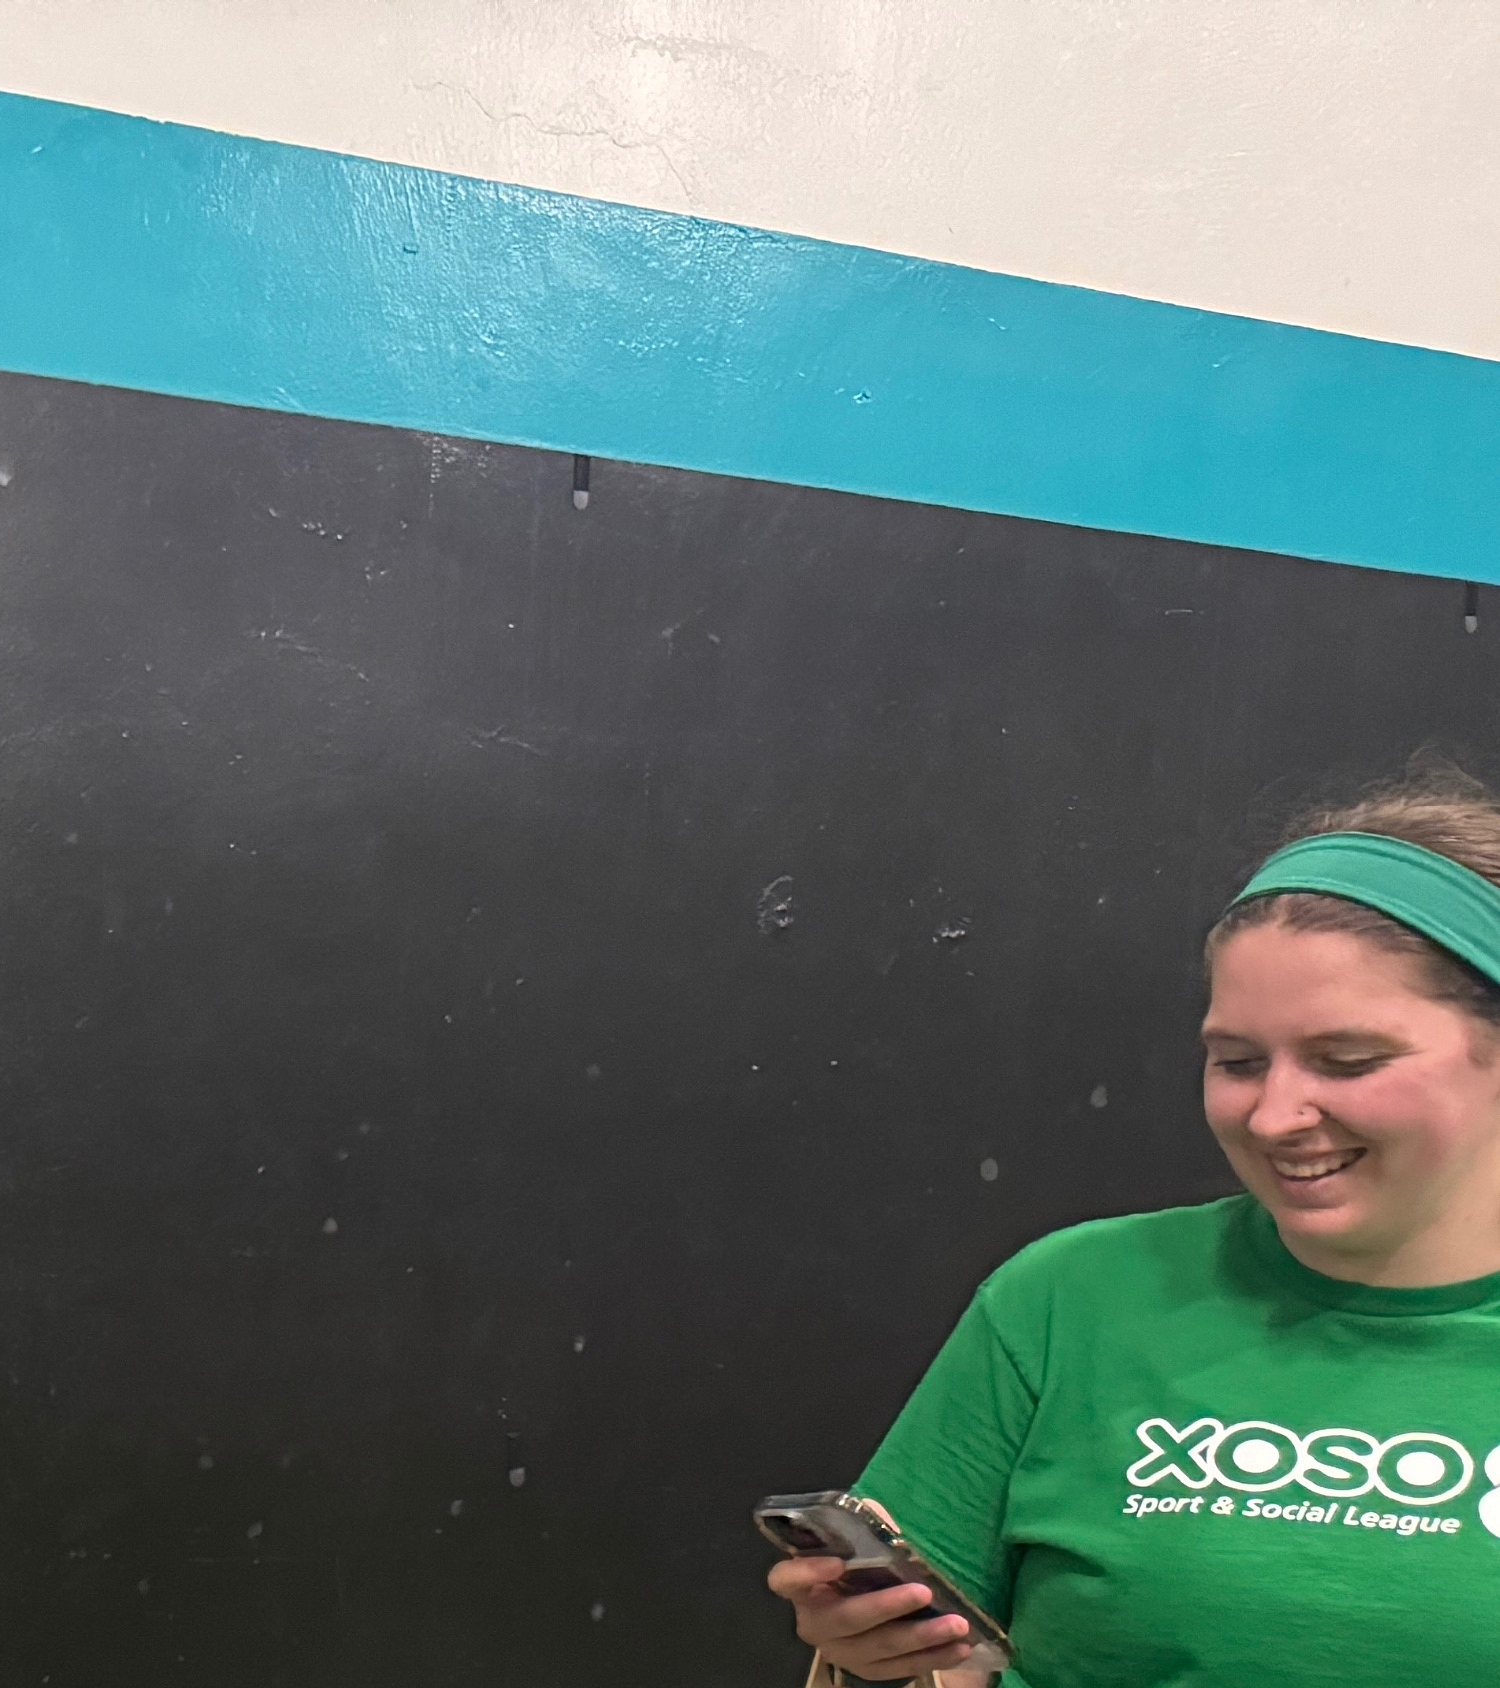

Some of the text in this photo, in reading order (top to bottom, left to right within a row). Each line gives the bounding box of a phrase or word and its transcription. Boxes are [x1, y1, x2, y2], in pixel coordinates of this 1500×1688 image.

[1126, 1417, 1474, 1505] XOSO
[1122, 1494, 1461, 1535] Sport & Social League
